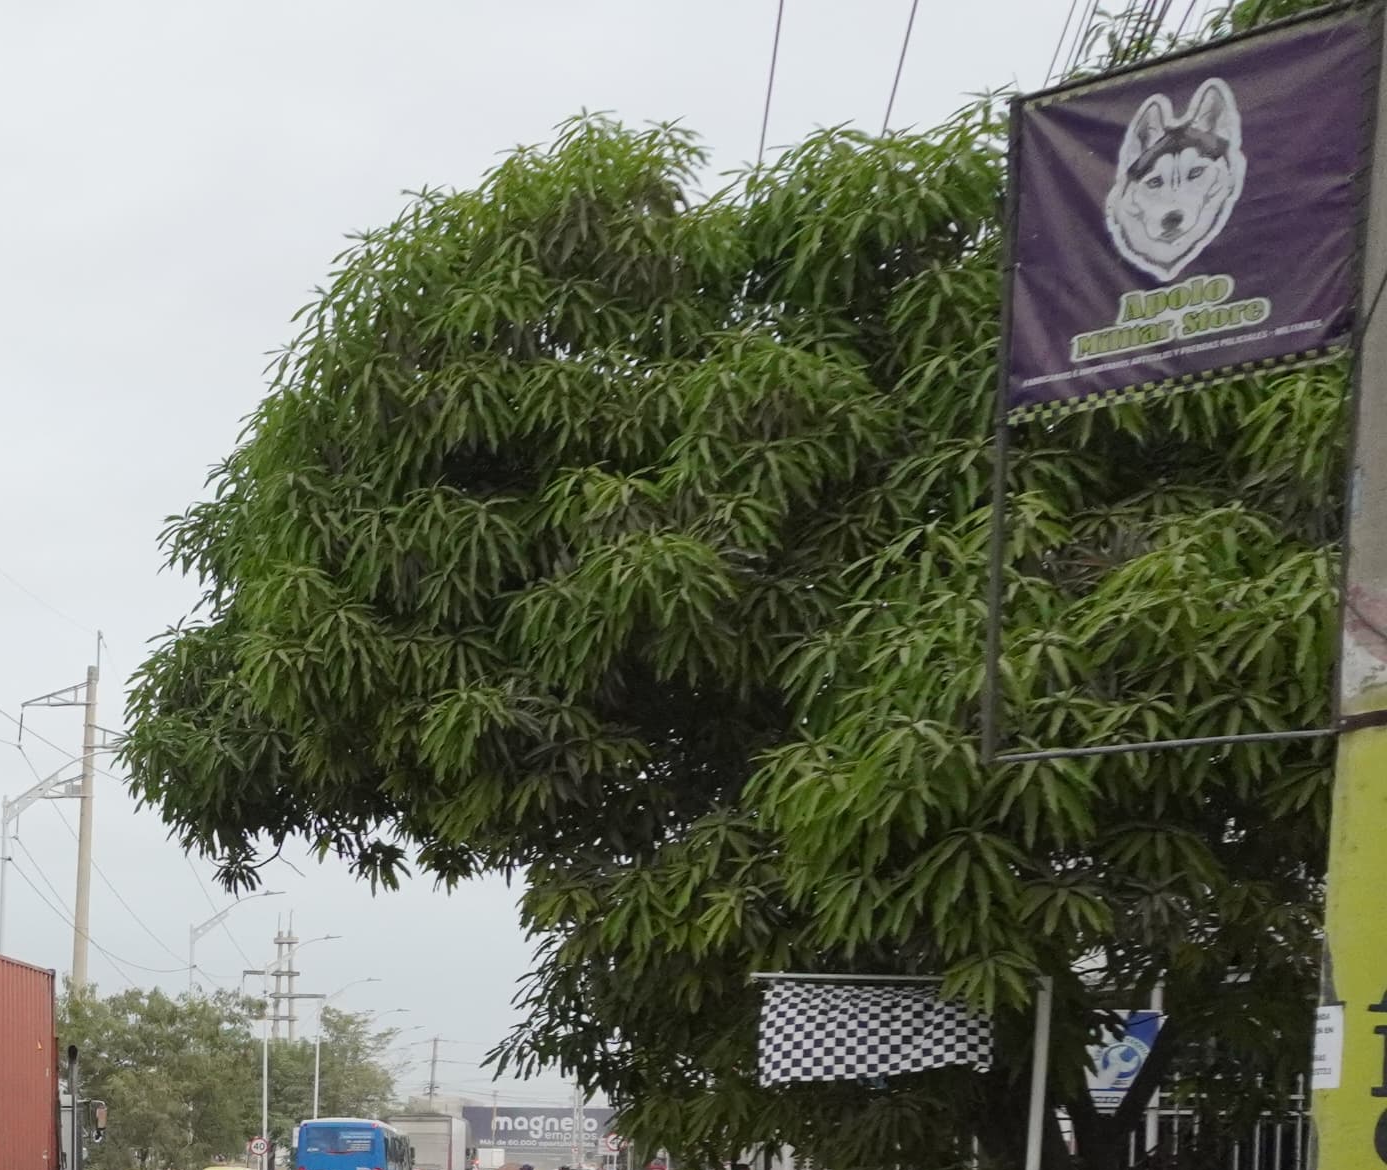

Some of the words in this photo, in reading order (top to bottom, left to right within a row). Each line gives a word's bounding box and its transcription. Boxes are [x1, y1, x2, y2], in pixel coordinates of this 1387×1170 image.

[1122, 276, 1229, 322] Apolo
[1182, 300, 1265, 336] Store
[253, 1142, 265, 1151] 40
